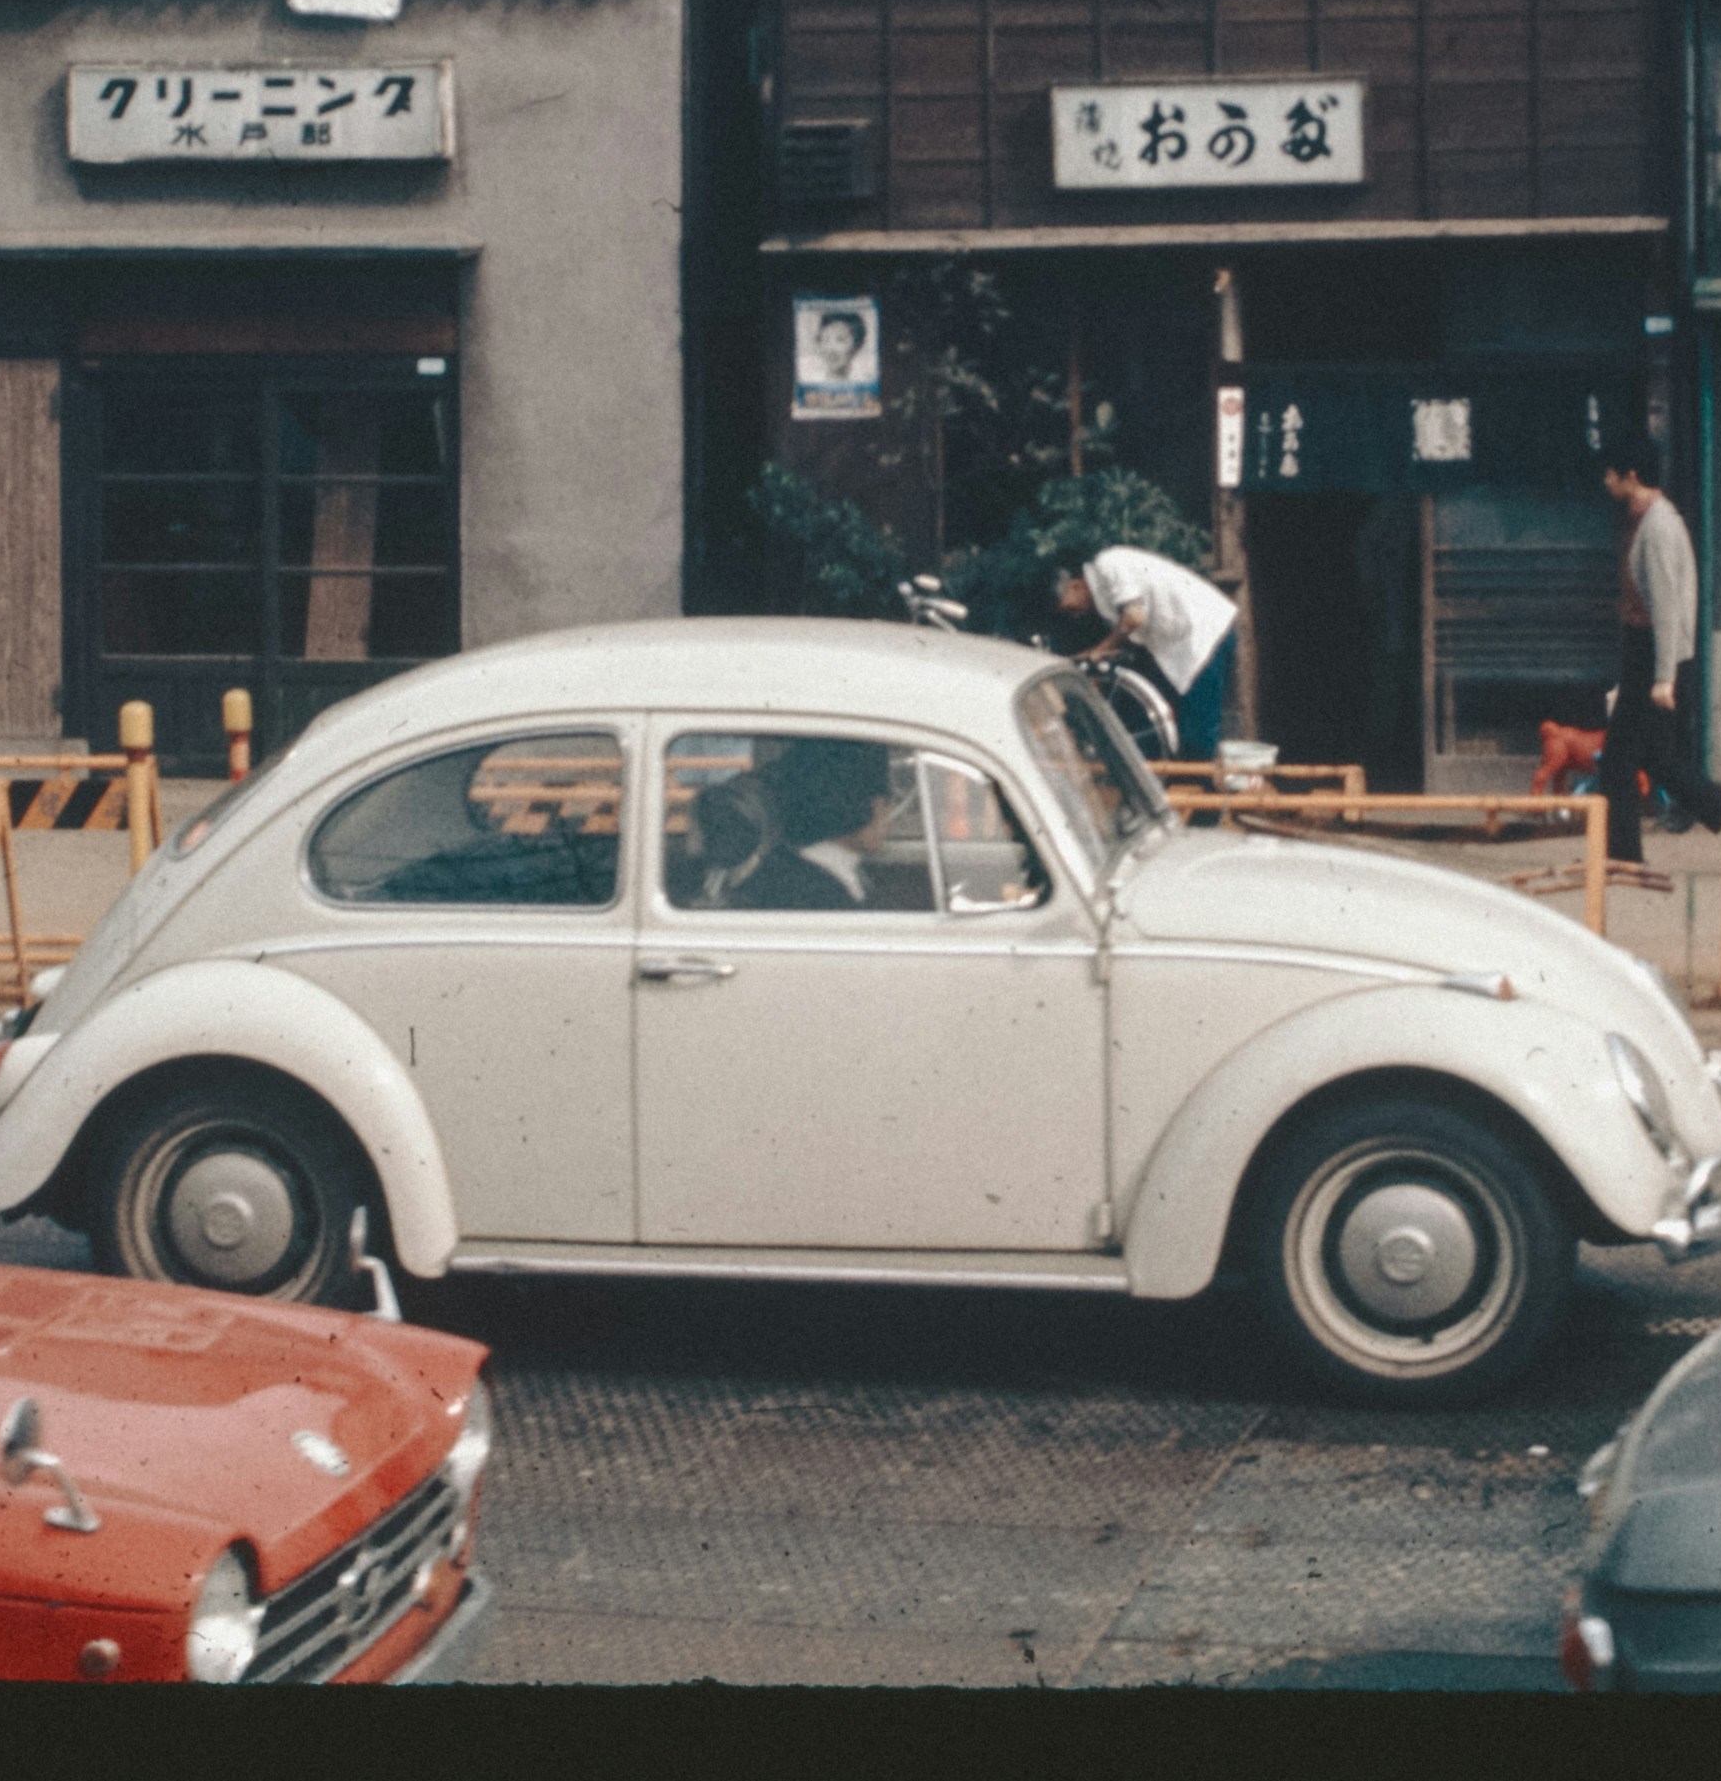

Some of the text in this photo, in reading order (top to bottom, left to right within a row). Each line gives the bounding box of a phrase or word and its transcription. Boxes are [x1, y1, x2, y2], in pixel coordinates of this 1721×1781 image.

[98, 76, 416, 120] クリーニング
